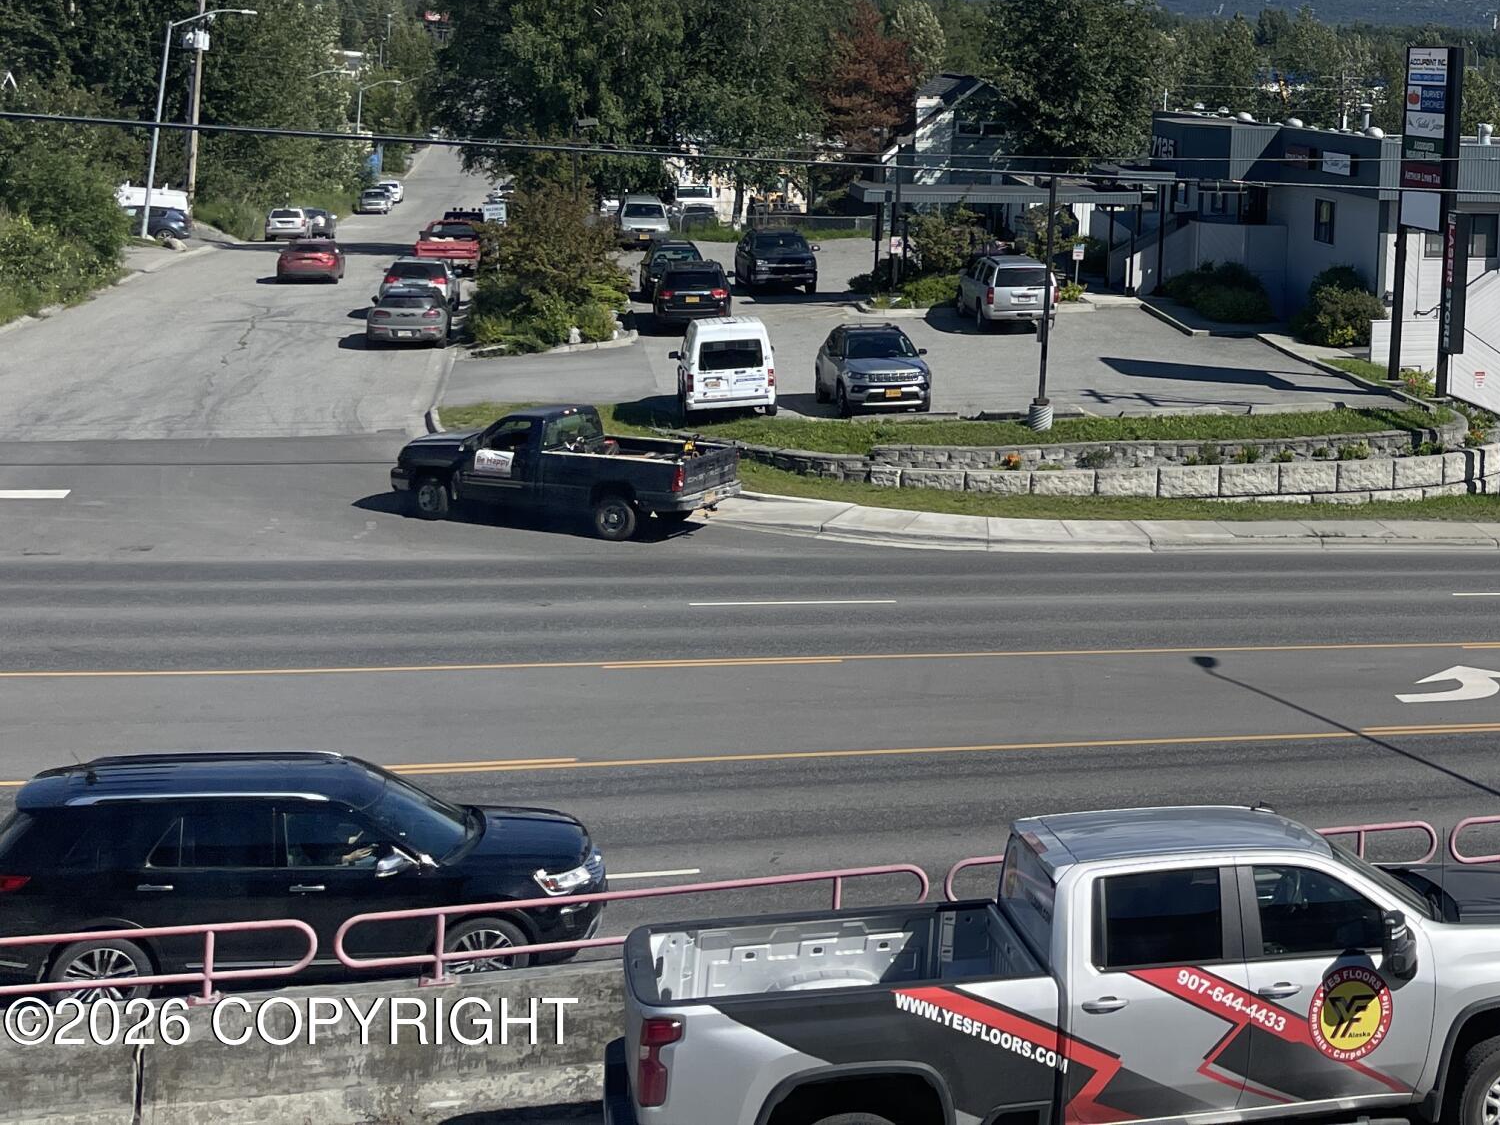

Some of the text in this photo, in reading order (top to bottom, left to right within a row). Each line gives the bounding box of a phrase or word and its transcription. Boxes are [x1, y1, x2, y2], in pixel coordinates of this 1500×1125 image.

[1422, 90, 1444, 99] SURVEY
[1422, 100, 1444, 109] DRONES
[1152, 135, 1174, 158] 7125
[1446, 225, 1456, 283] LASER
[1443, 288, 1452, 348] STORE
[487, 457, 510, 467] Happy
[1323, 970, 1383, 992] YES FLOORS
[1176, 970, 1287, 1032] 907-644-4433
[895, 992, 1069, 1075] WWW.YESFLOORS.COM
[1311, 999, 1328, 1051] Remnants
[1333, 1049, 1367, 1060] Carpet
[1382, 996, 1390, 1016] Tile
[1348, 1030, 1371, 1039] Alaska
